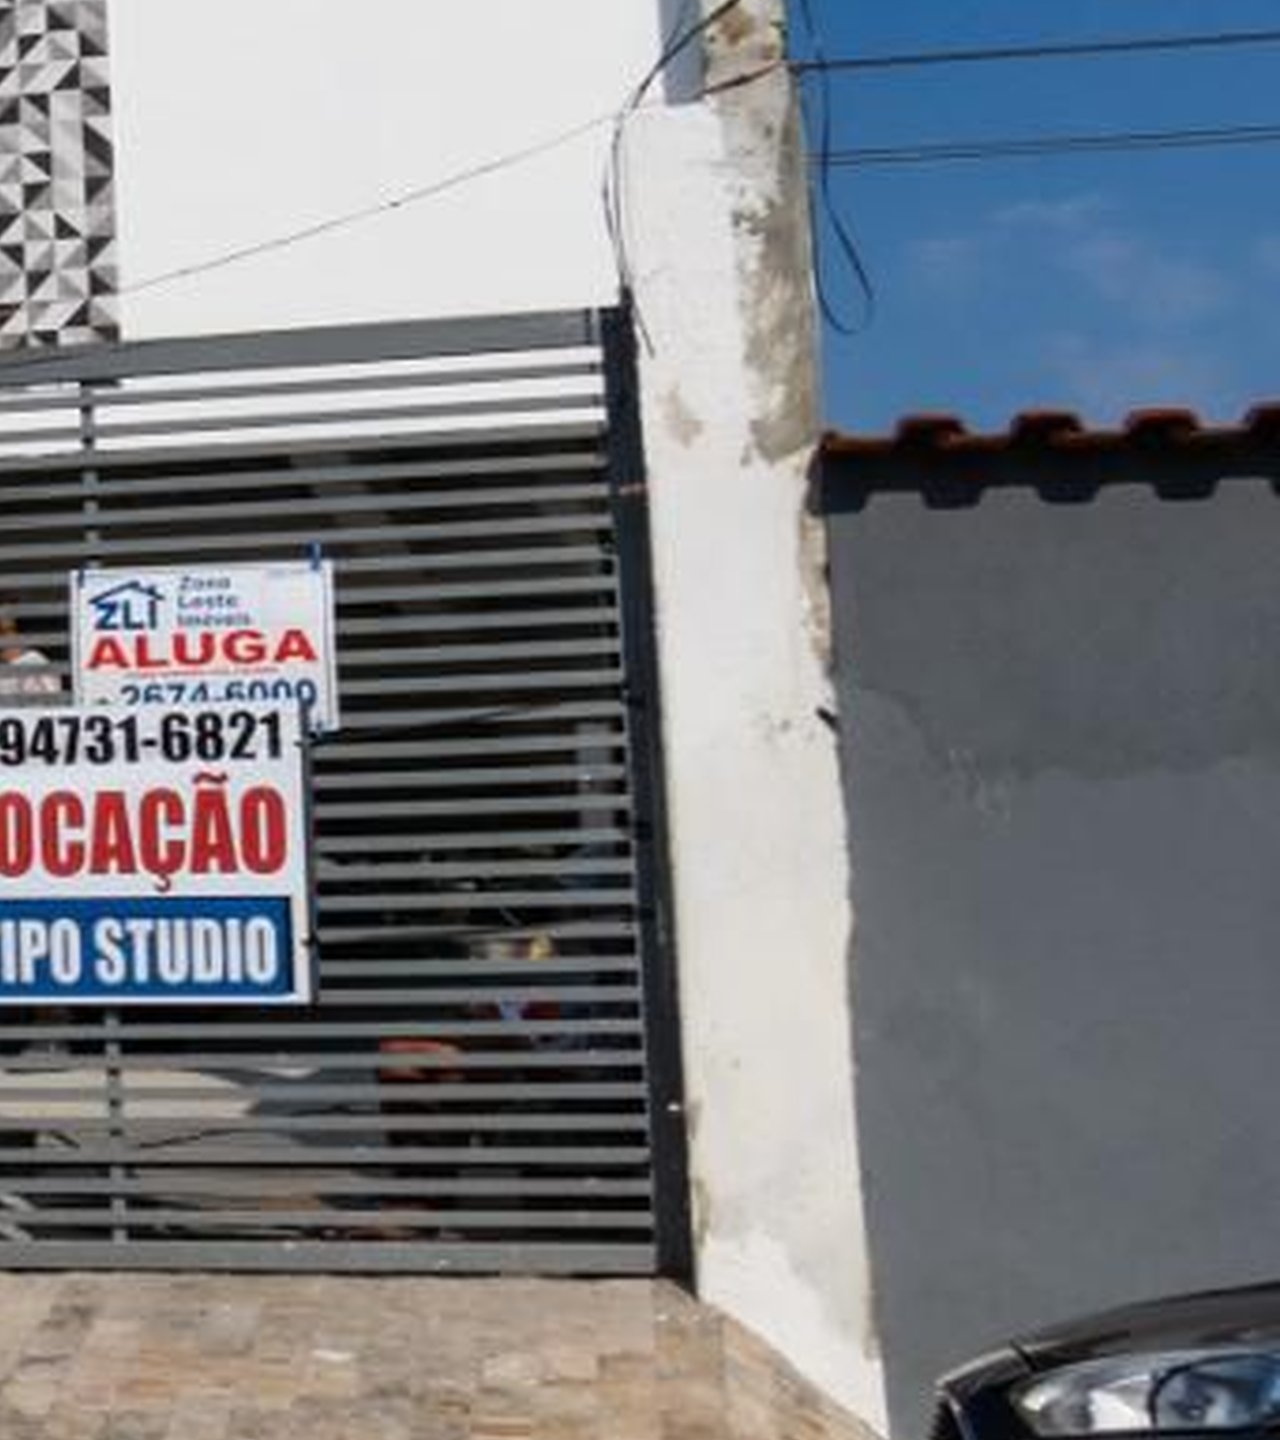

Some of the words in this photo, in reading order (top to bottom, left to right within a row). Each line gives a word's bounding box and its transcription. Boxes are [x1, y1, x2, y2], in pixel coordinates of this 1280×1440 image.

[94, 600, 157, 630] ZLI
[177, 594, 238, 609] Leste
[88, 629, 318, 668] ALUGA
[94, 917, 278, 986] STUDIO
